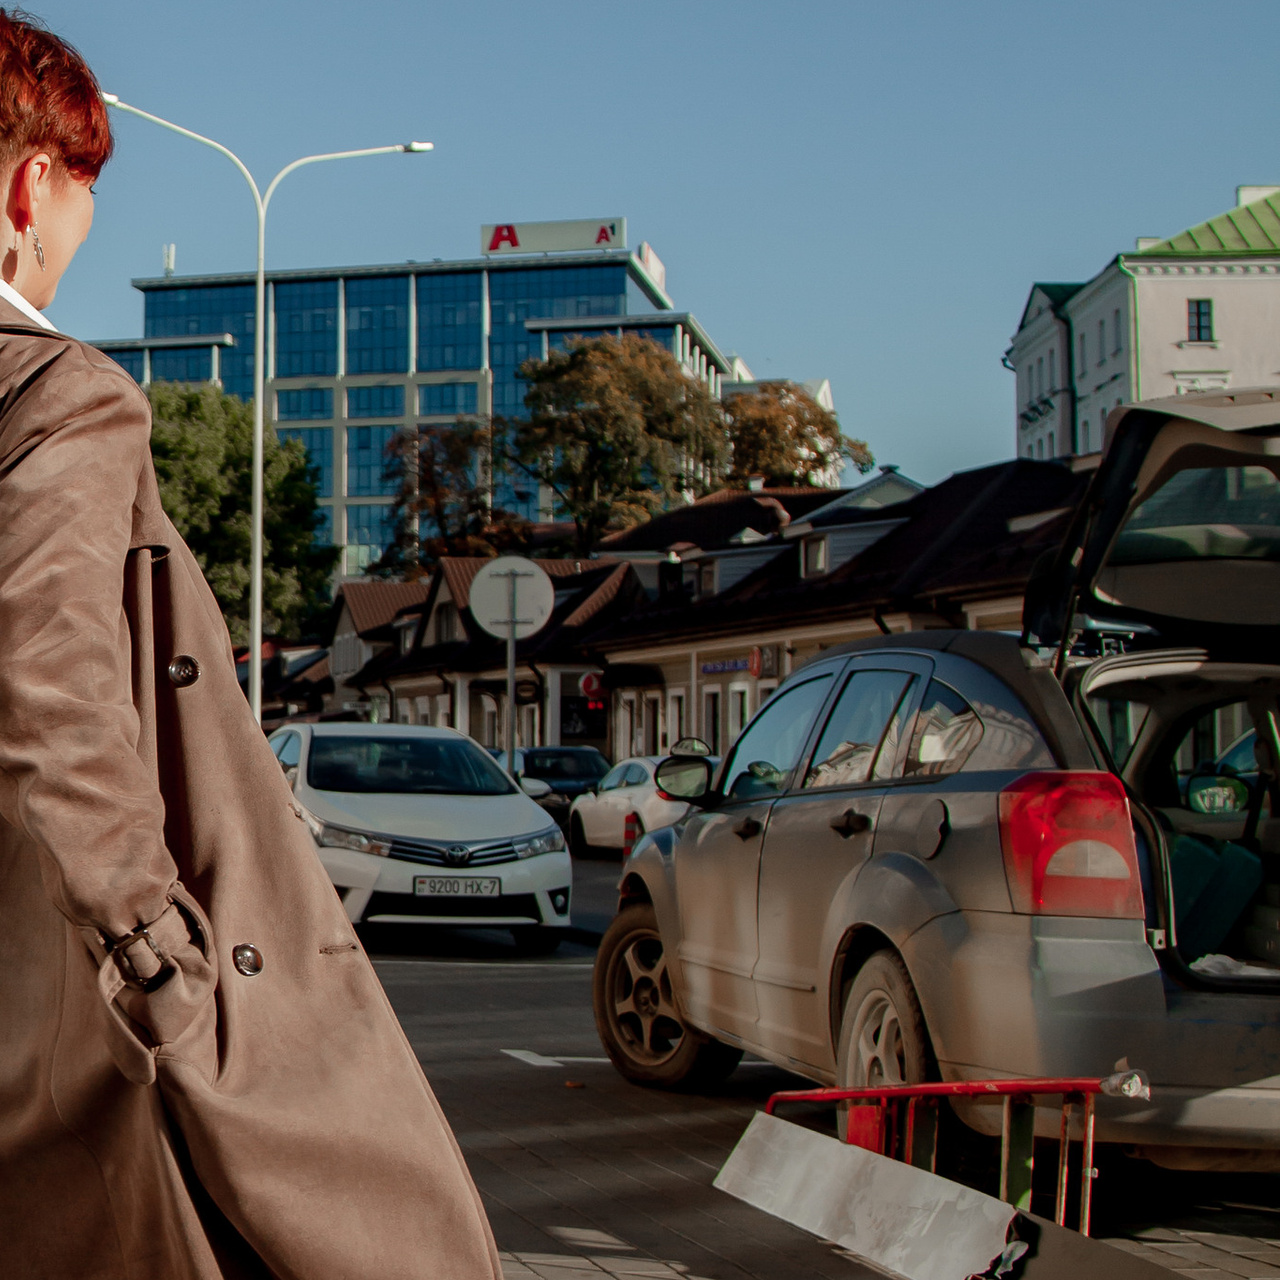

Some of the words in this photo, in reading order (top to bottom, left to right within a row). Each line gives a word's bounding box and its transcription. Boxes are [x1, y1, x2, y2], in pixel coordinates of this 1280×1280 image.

[595, 222, 616, 245] A1
[429, 880, 460, 894] 9200
[464, 880, 497, 895] HX-7
